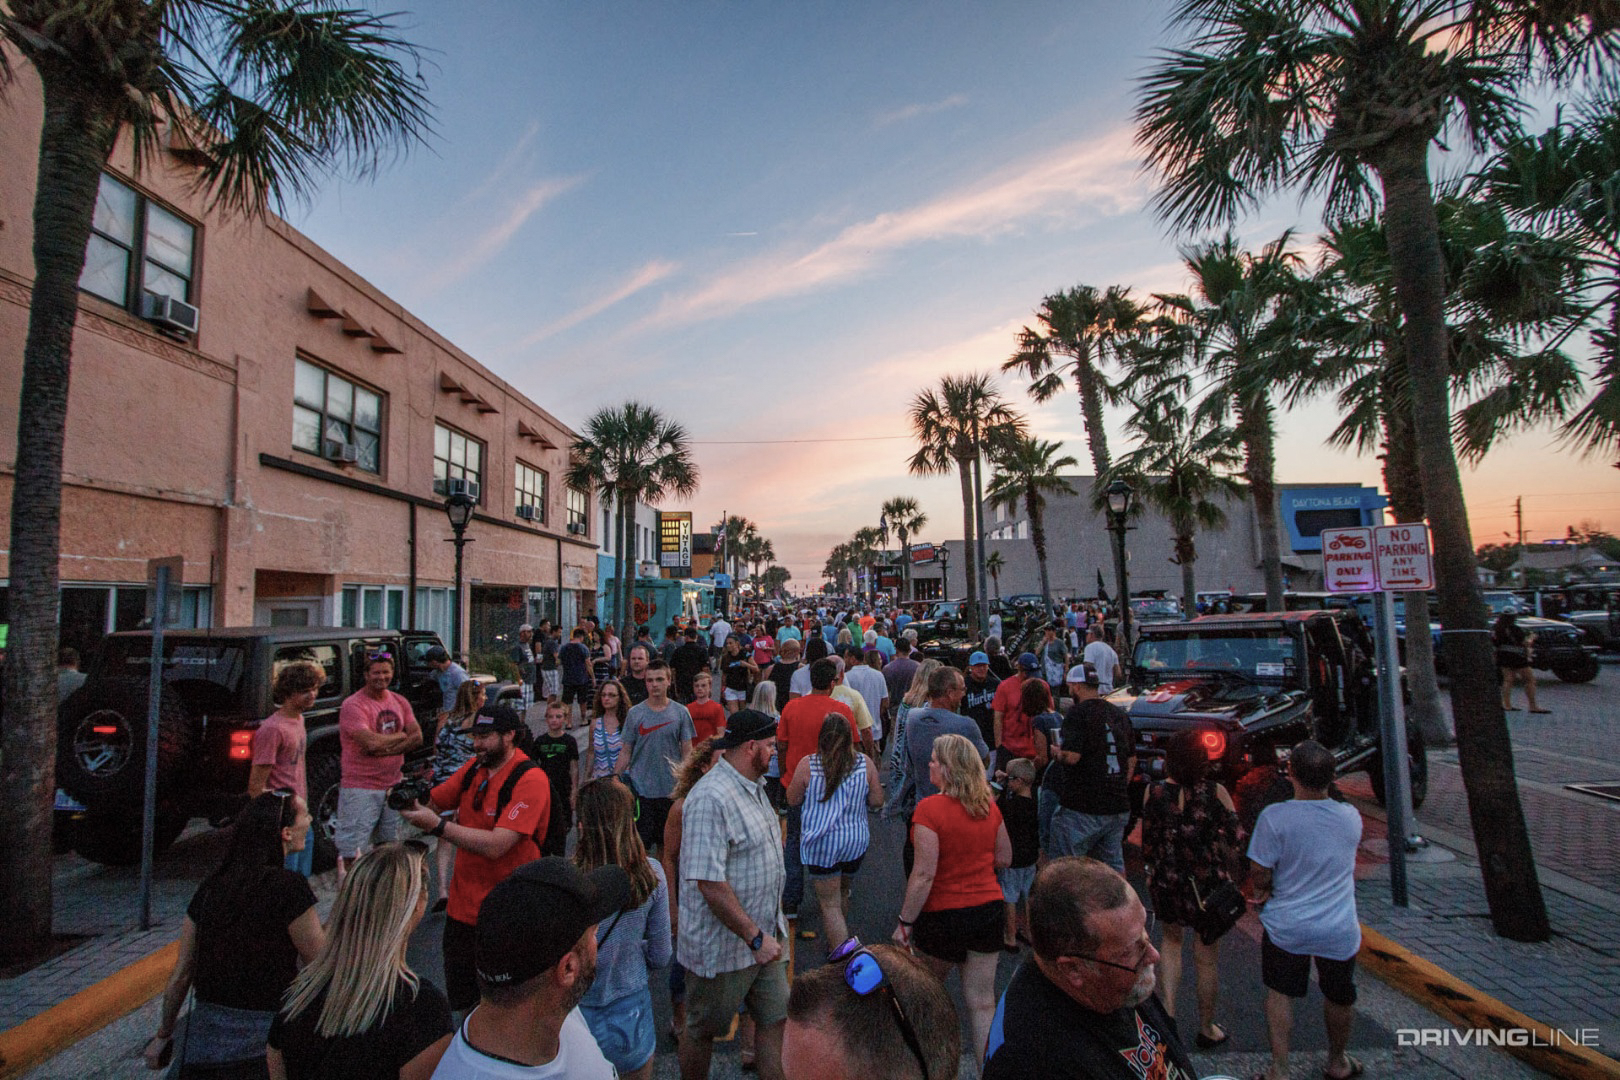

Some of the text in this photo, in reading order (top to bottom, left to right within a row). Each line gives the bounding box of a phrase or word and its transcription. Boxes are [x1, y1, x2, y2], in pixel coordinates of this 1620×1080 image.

[1292, 496, 1360, 507] DAYTONA BEACH
[1390, 528, 1411, 542] NO
[1379, 542, 1426, 557] PARKING
[1326, 552, 1373, 562] PARKING
[1392, 557, 1414, 566] ANY
[1336, 567, 1363, 577] ONLY
[1391, 567, 1417, 577] TIME
